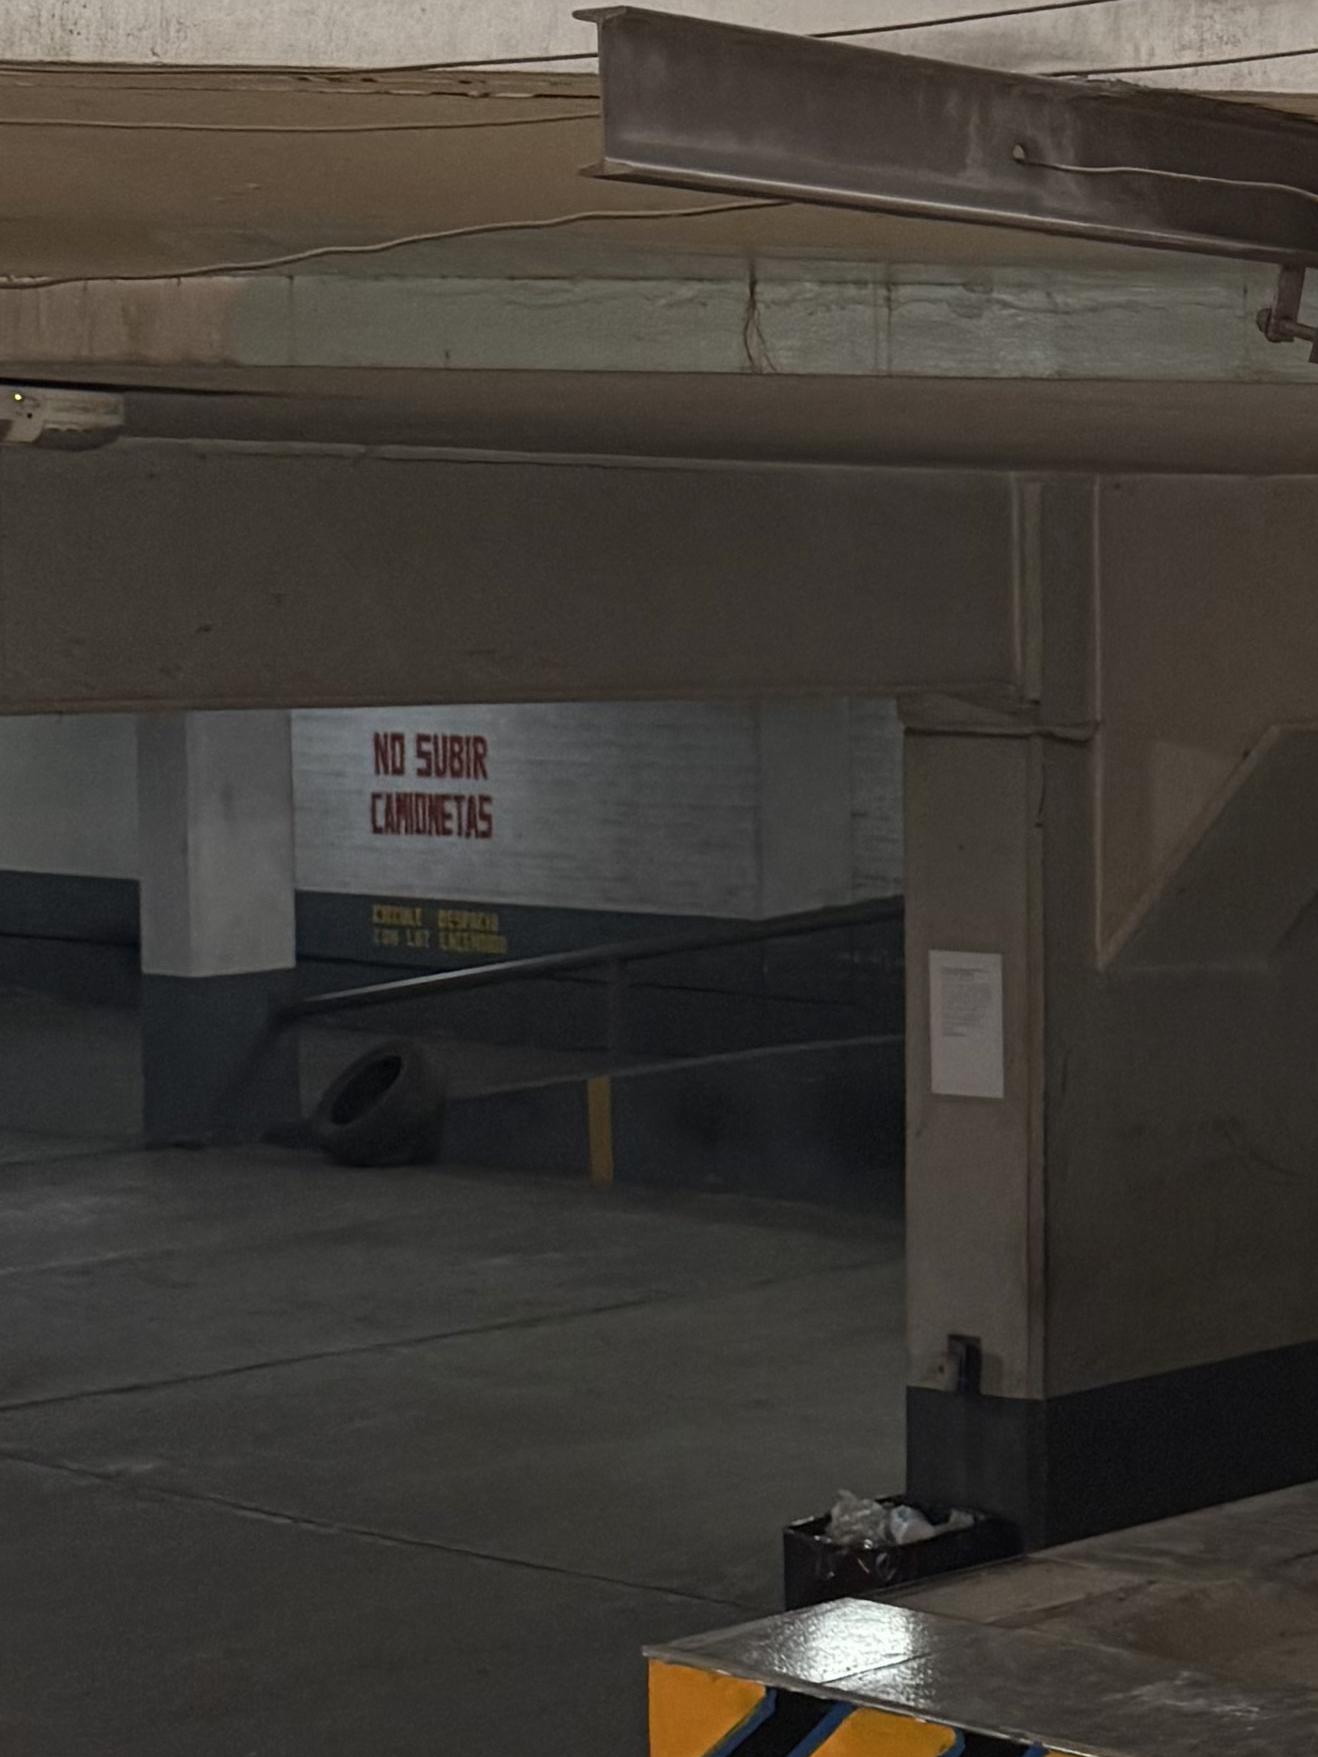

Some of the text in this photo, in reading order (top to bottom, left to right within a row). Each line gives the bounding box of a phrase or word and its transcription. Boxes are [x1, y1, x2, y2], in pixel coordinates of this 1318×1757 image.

[373, 732, 488, 780] NO SUBIR
[371, 792, 493, 839] CAMIONETAS
